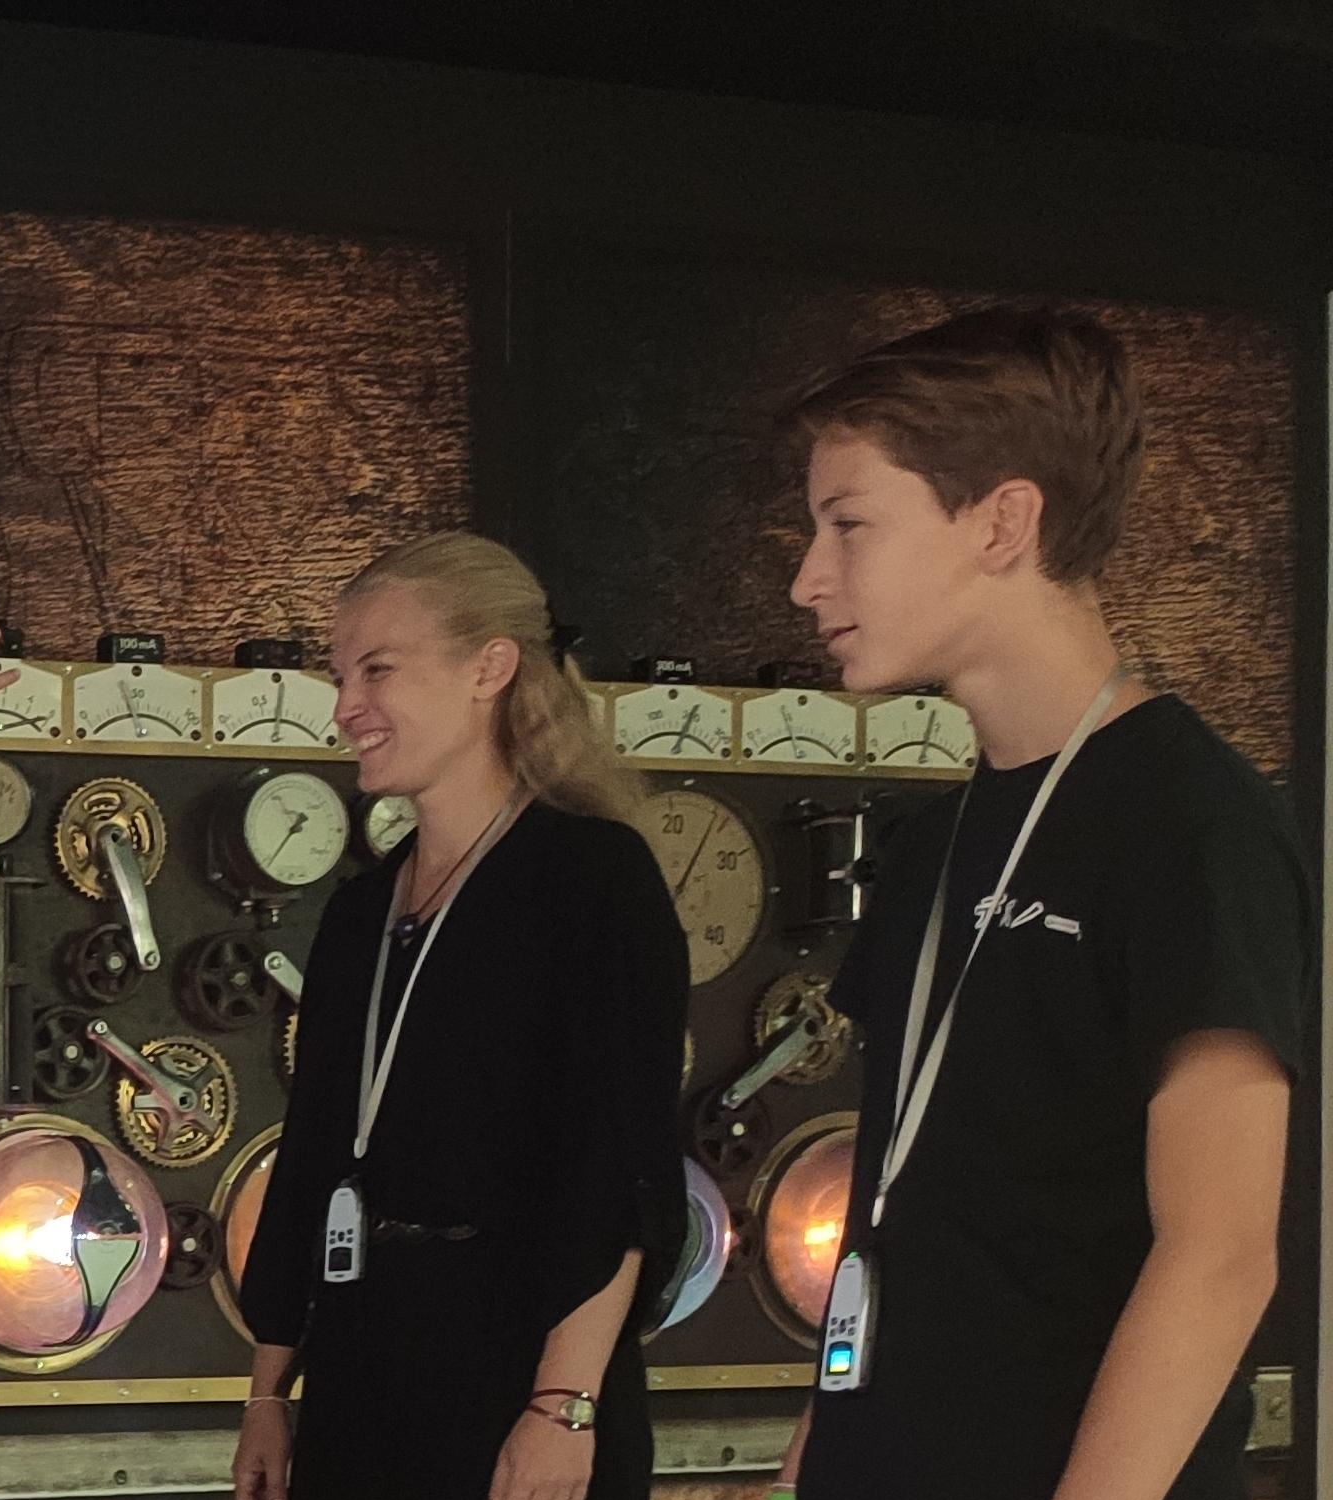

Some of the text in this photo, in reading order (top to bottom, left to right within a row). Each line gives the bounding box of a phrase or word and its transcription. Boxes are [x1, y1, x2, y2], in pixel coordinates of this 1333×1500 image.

[662, 814, 683, 834] 20
[716, 851, 737, 871] 30
[704, 925, 724, 945] 40
